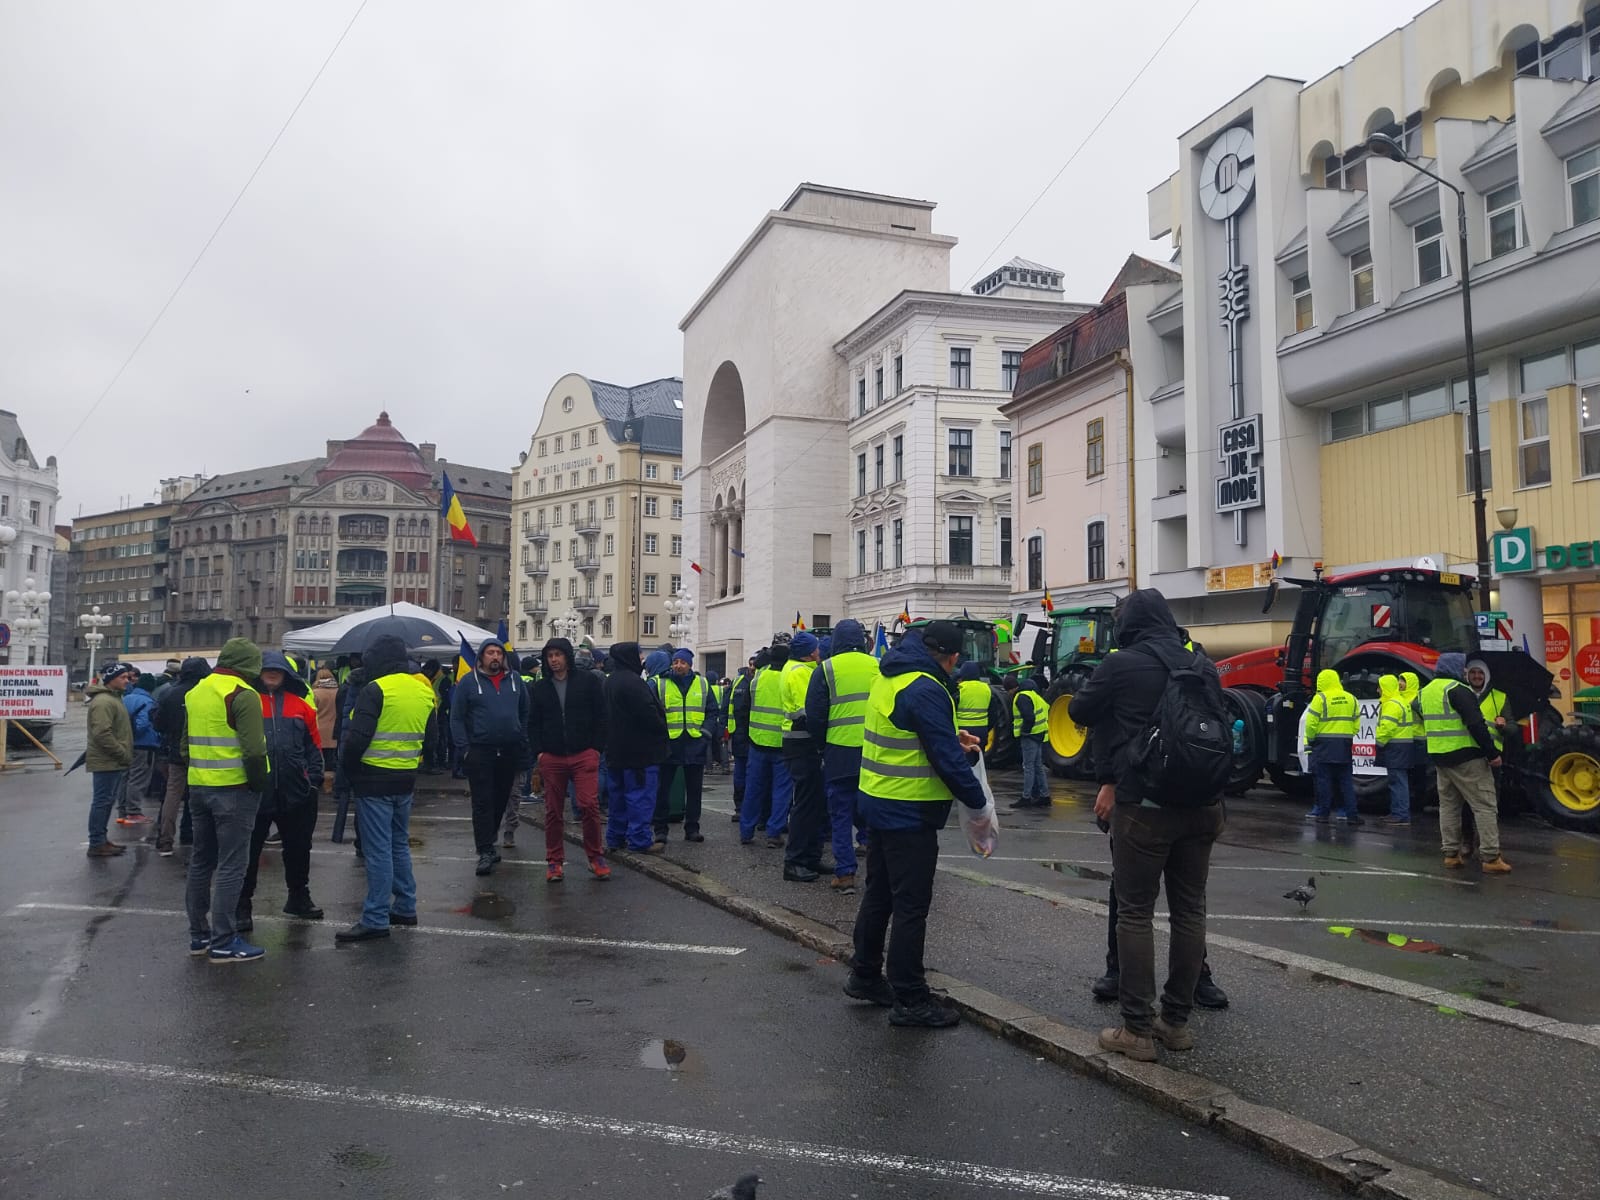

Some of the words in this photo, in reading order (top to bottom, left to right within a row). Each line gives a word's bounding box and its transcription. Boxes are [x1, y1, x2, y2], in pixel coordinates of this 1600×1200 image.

[1223, 423, 1255, 453] CASA
[1231, 451, 1248, 477] DE
[1220, 476, 1257, 505] MODE
[1500, 536, 1526, 565] D
